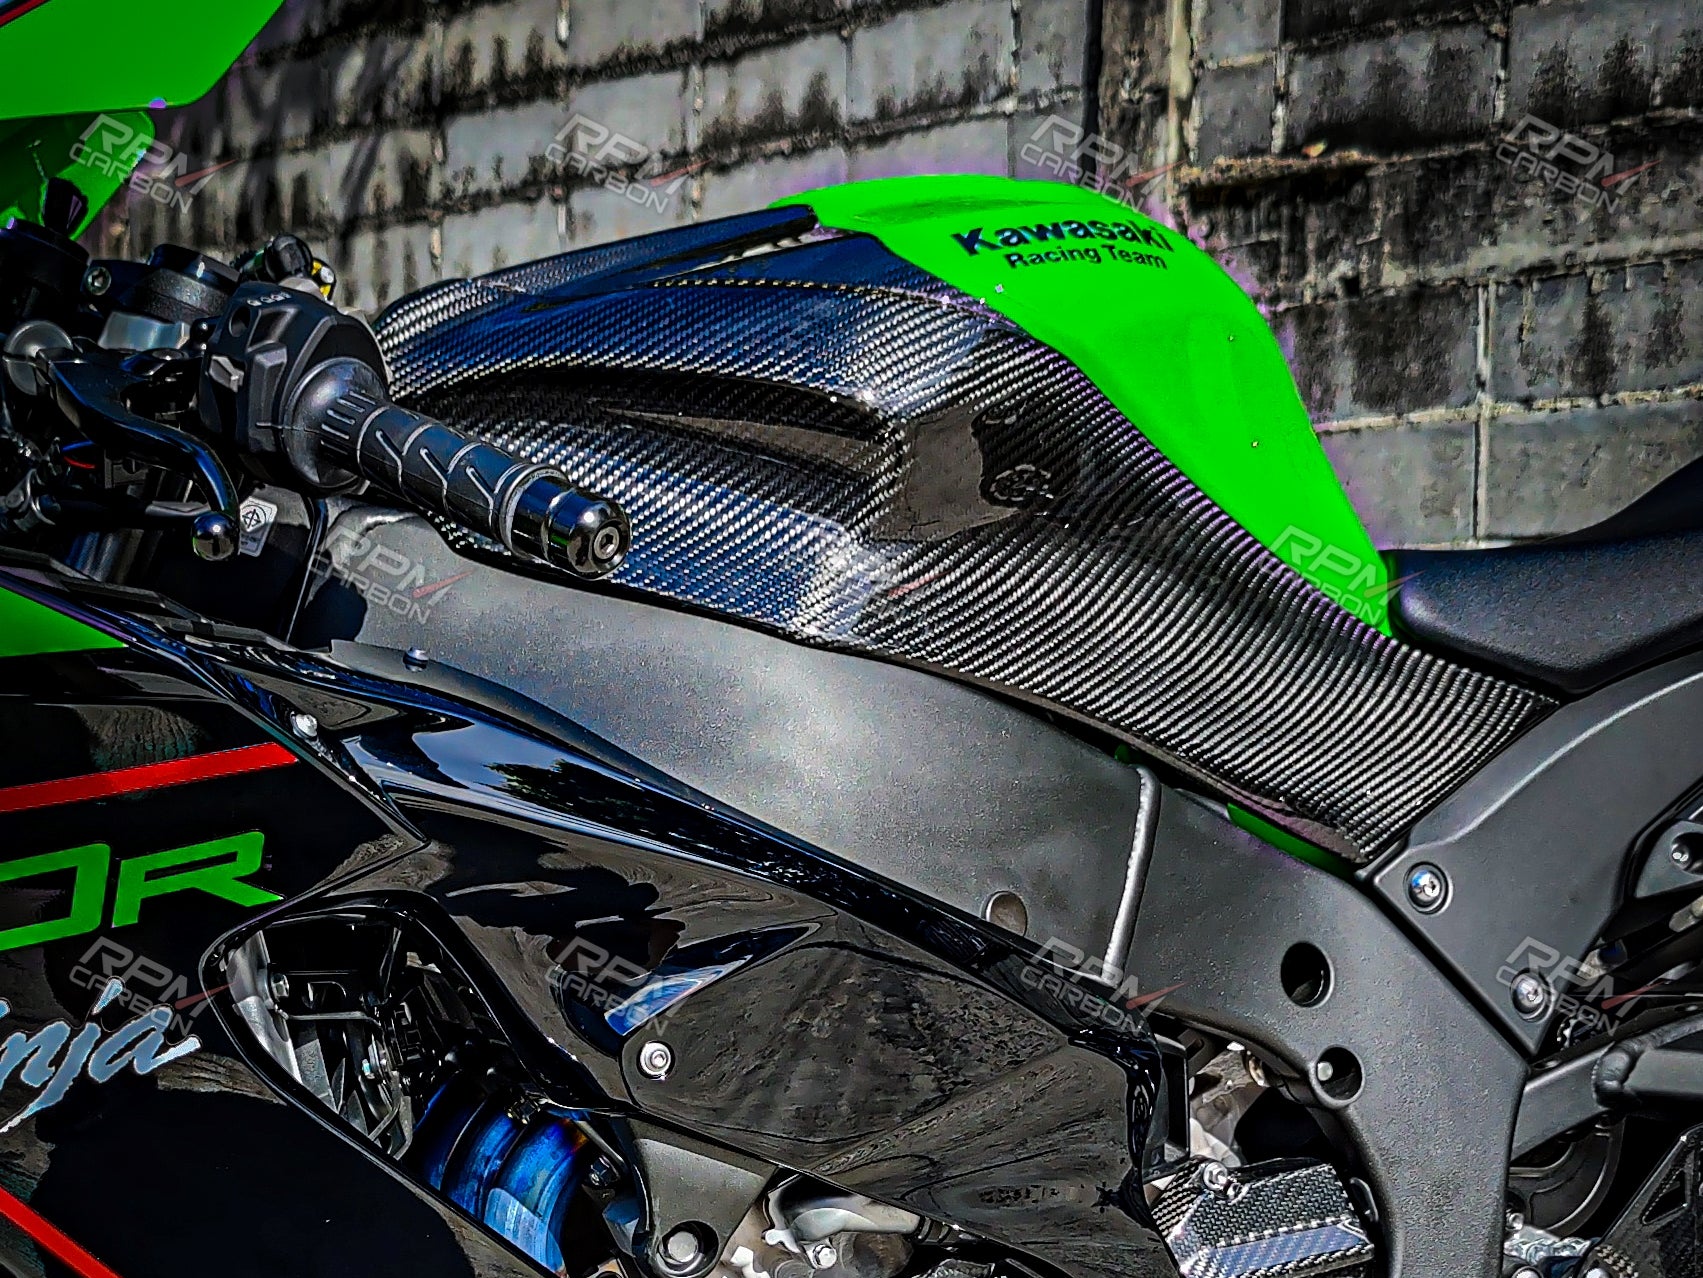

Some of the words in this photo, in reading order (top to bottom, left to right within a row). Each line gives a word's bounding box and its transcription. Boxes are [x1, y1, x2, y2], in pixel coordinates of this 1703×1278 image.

[951, 219, 1174, 257] Kawasaki
[1004, 246, 1102, 269] Racing
[1101, 244, 1168, 270] Team
